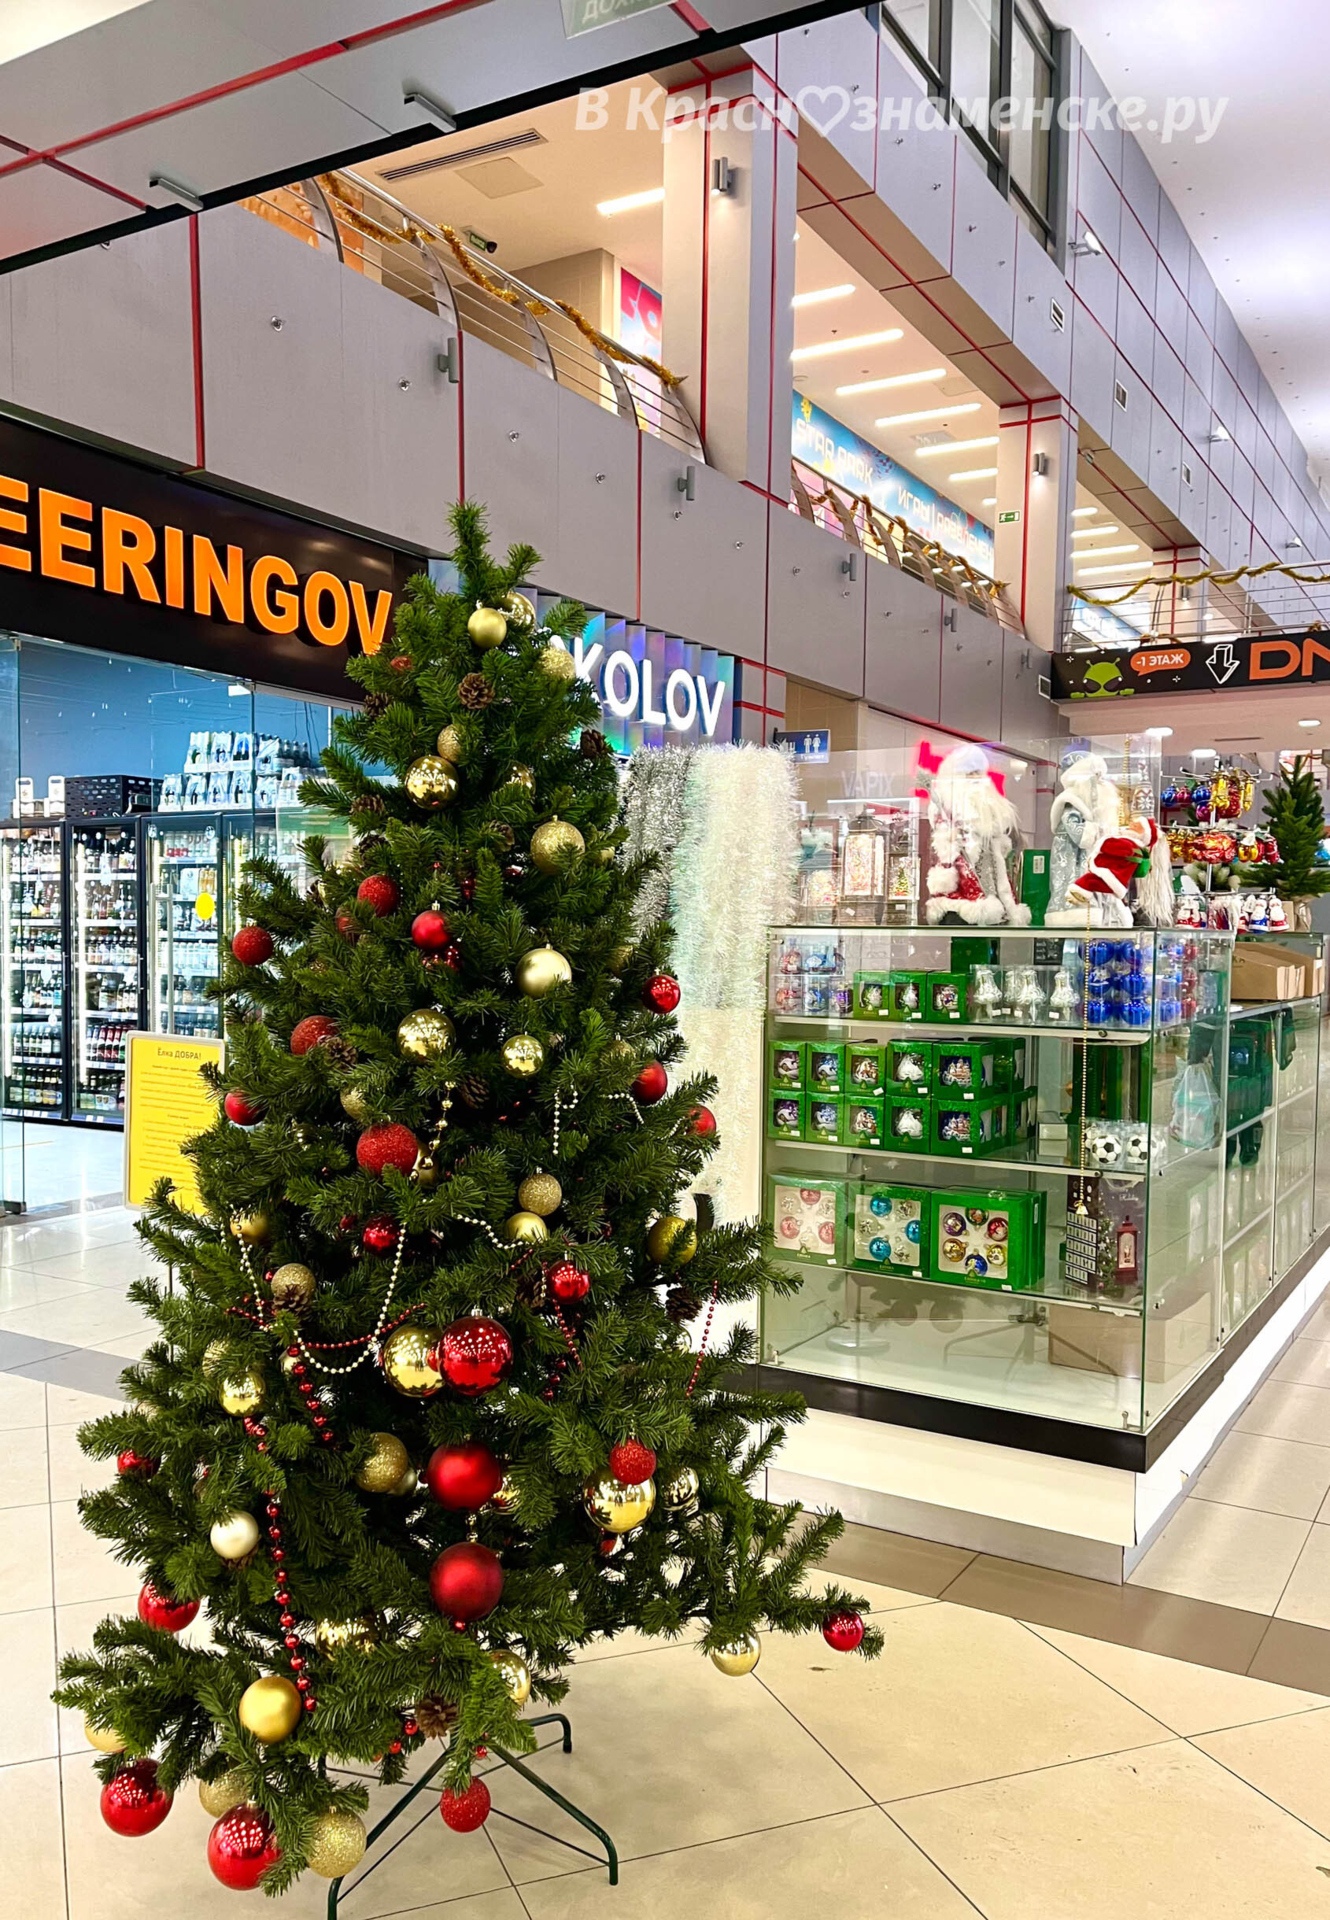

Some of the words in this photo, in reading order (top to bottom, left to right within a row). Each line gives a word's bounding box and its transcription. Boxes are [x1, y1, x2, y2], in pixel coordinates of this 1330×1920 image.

[897, 486, 930, 523] ИГРЫ
[1136, 656, 1146, 667] -1
[1148, 653, 1184, 666] ЭТАЖ
[551, 635, 726, 737] KOLOV
[157, 1047, 173, 1058] Ёлка
[174, 1050, 202, 1060] ДОБРА!
